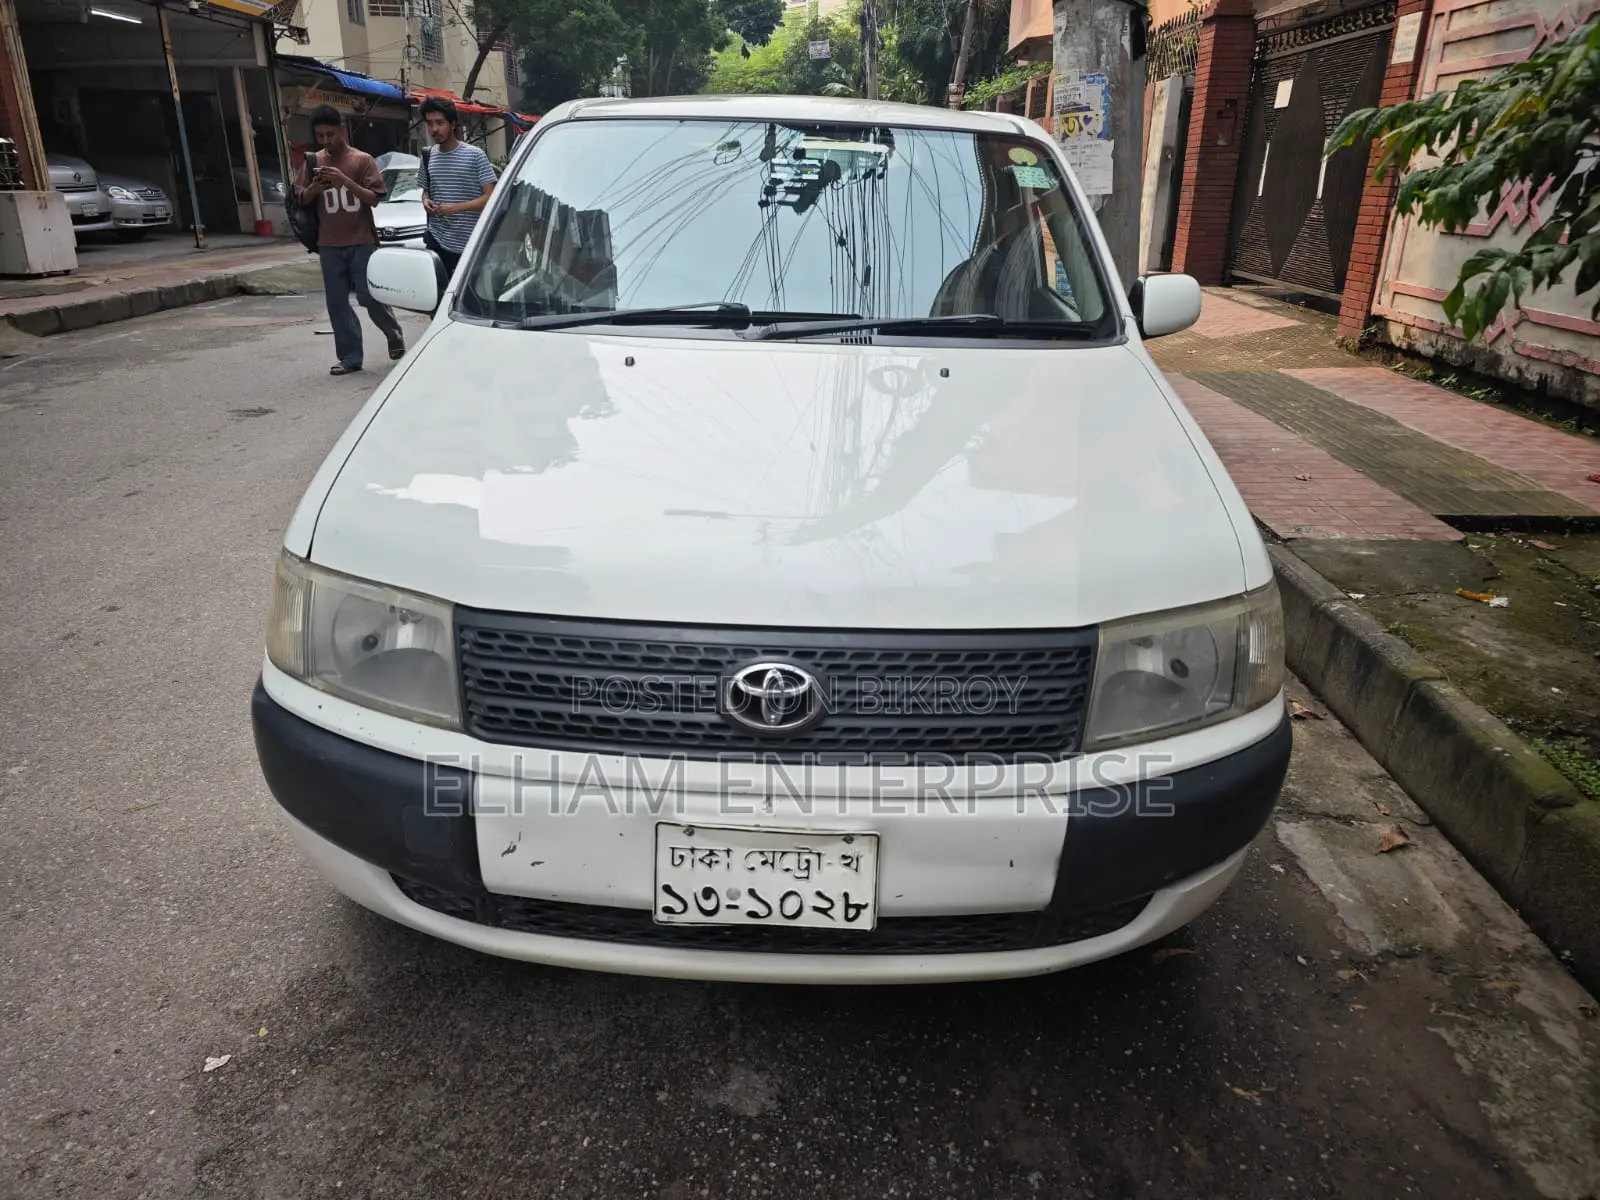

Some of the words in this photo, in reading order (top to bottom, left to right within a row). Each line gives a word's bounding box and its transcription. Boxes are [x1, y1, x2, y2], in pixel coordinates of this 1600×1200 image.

[323, 184, 361, 213] 00
[669, 846, 733, 870] ঢাকা
[661, 883, 869, 923] ১৩-১০২৮
